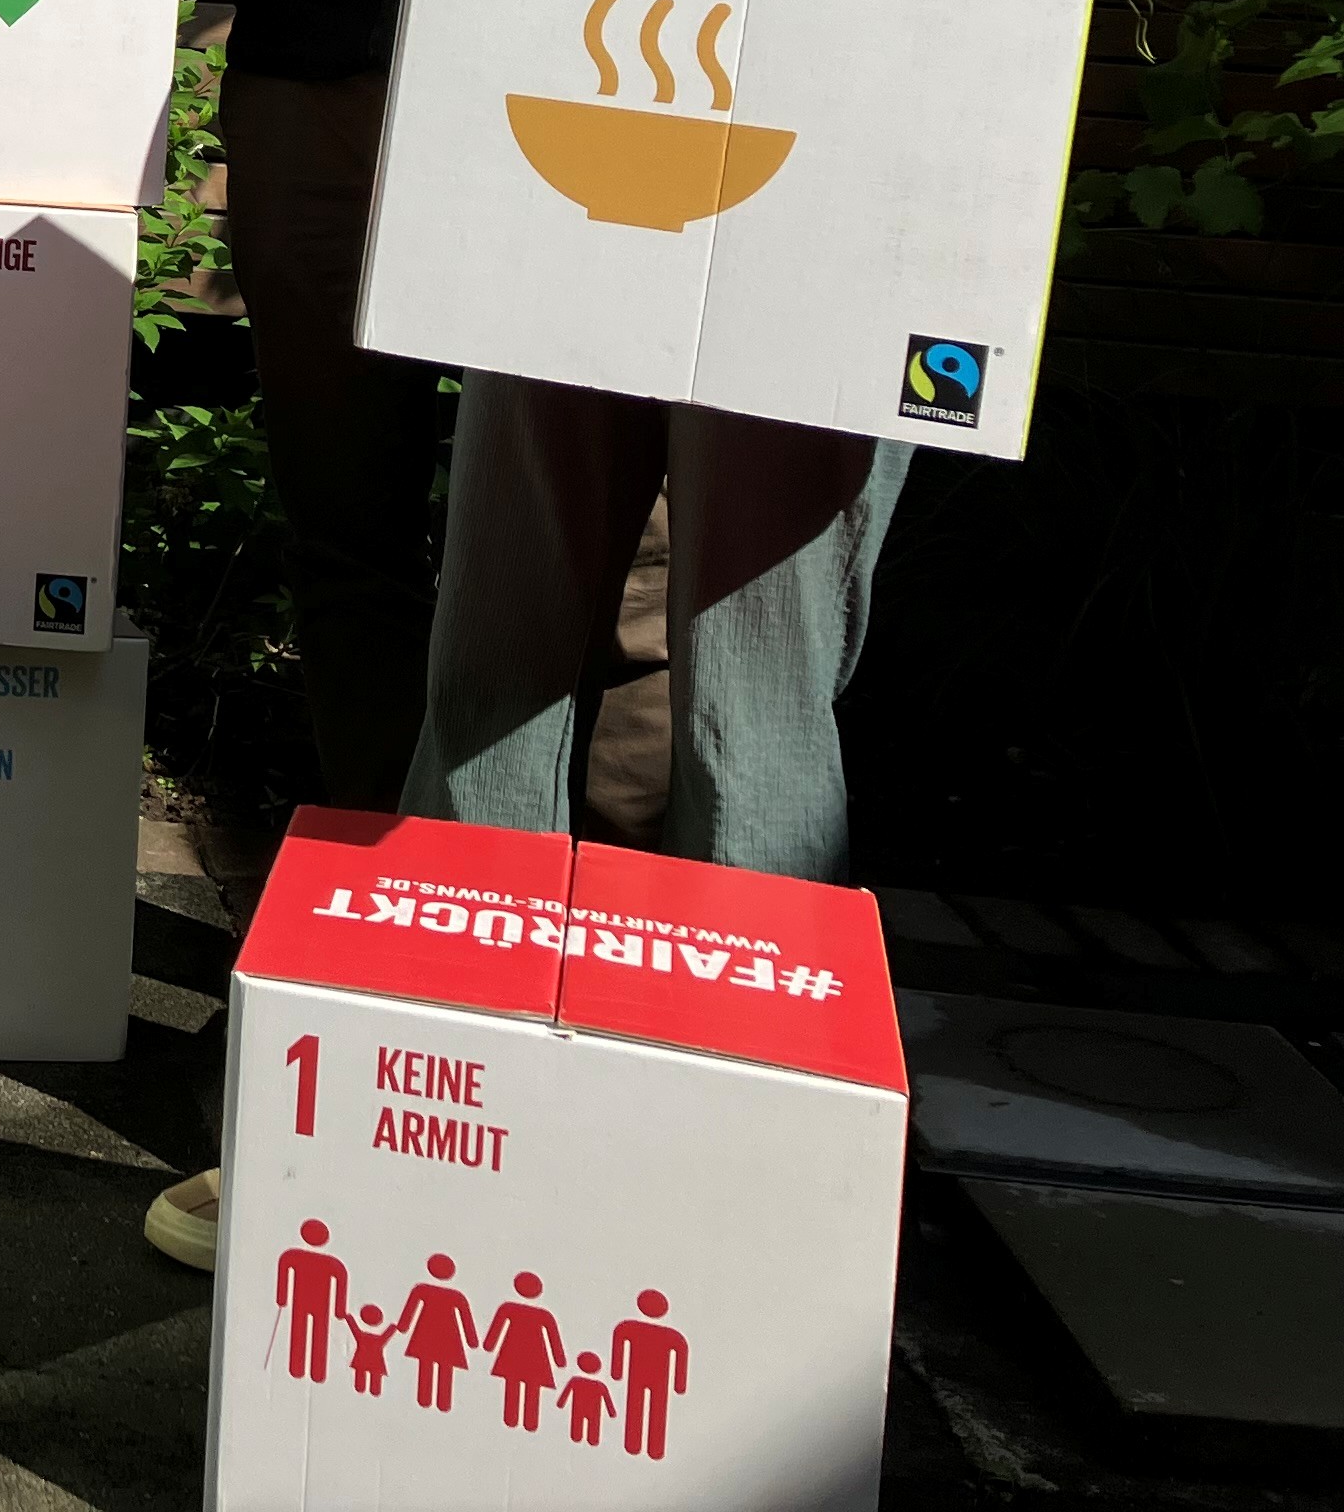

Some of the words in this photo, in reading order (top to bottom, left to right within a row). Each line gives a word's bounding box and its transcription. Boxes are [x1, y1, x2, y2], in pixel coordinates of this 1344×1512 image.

[902, 402, 975, 425] FAIRTRADE
[36, 620, 83, 633] FAIRTRADE
[313, 888, 844, 1001] #FAIRRÜCKT
[376, 876, 781, 954] WWW.FAIRTRADE-TOWNS.DE
[286, 1034, 319, 1137] 1
[376, 1046, 486, 1108] KEINE
[372, 1106, 509, 1172] ARMUT
